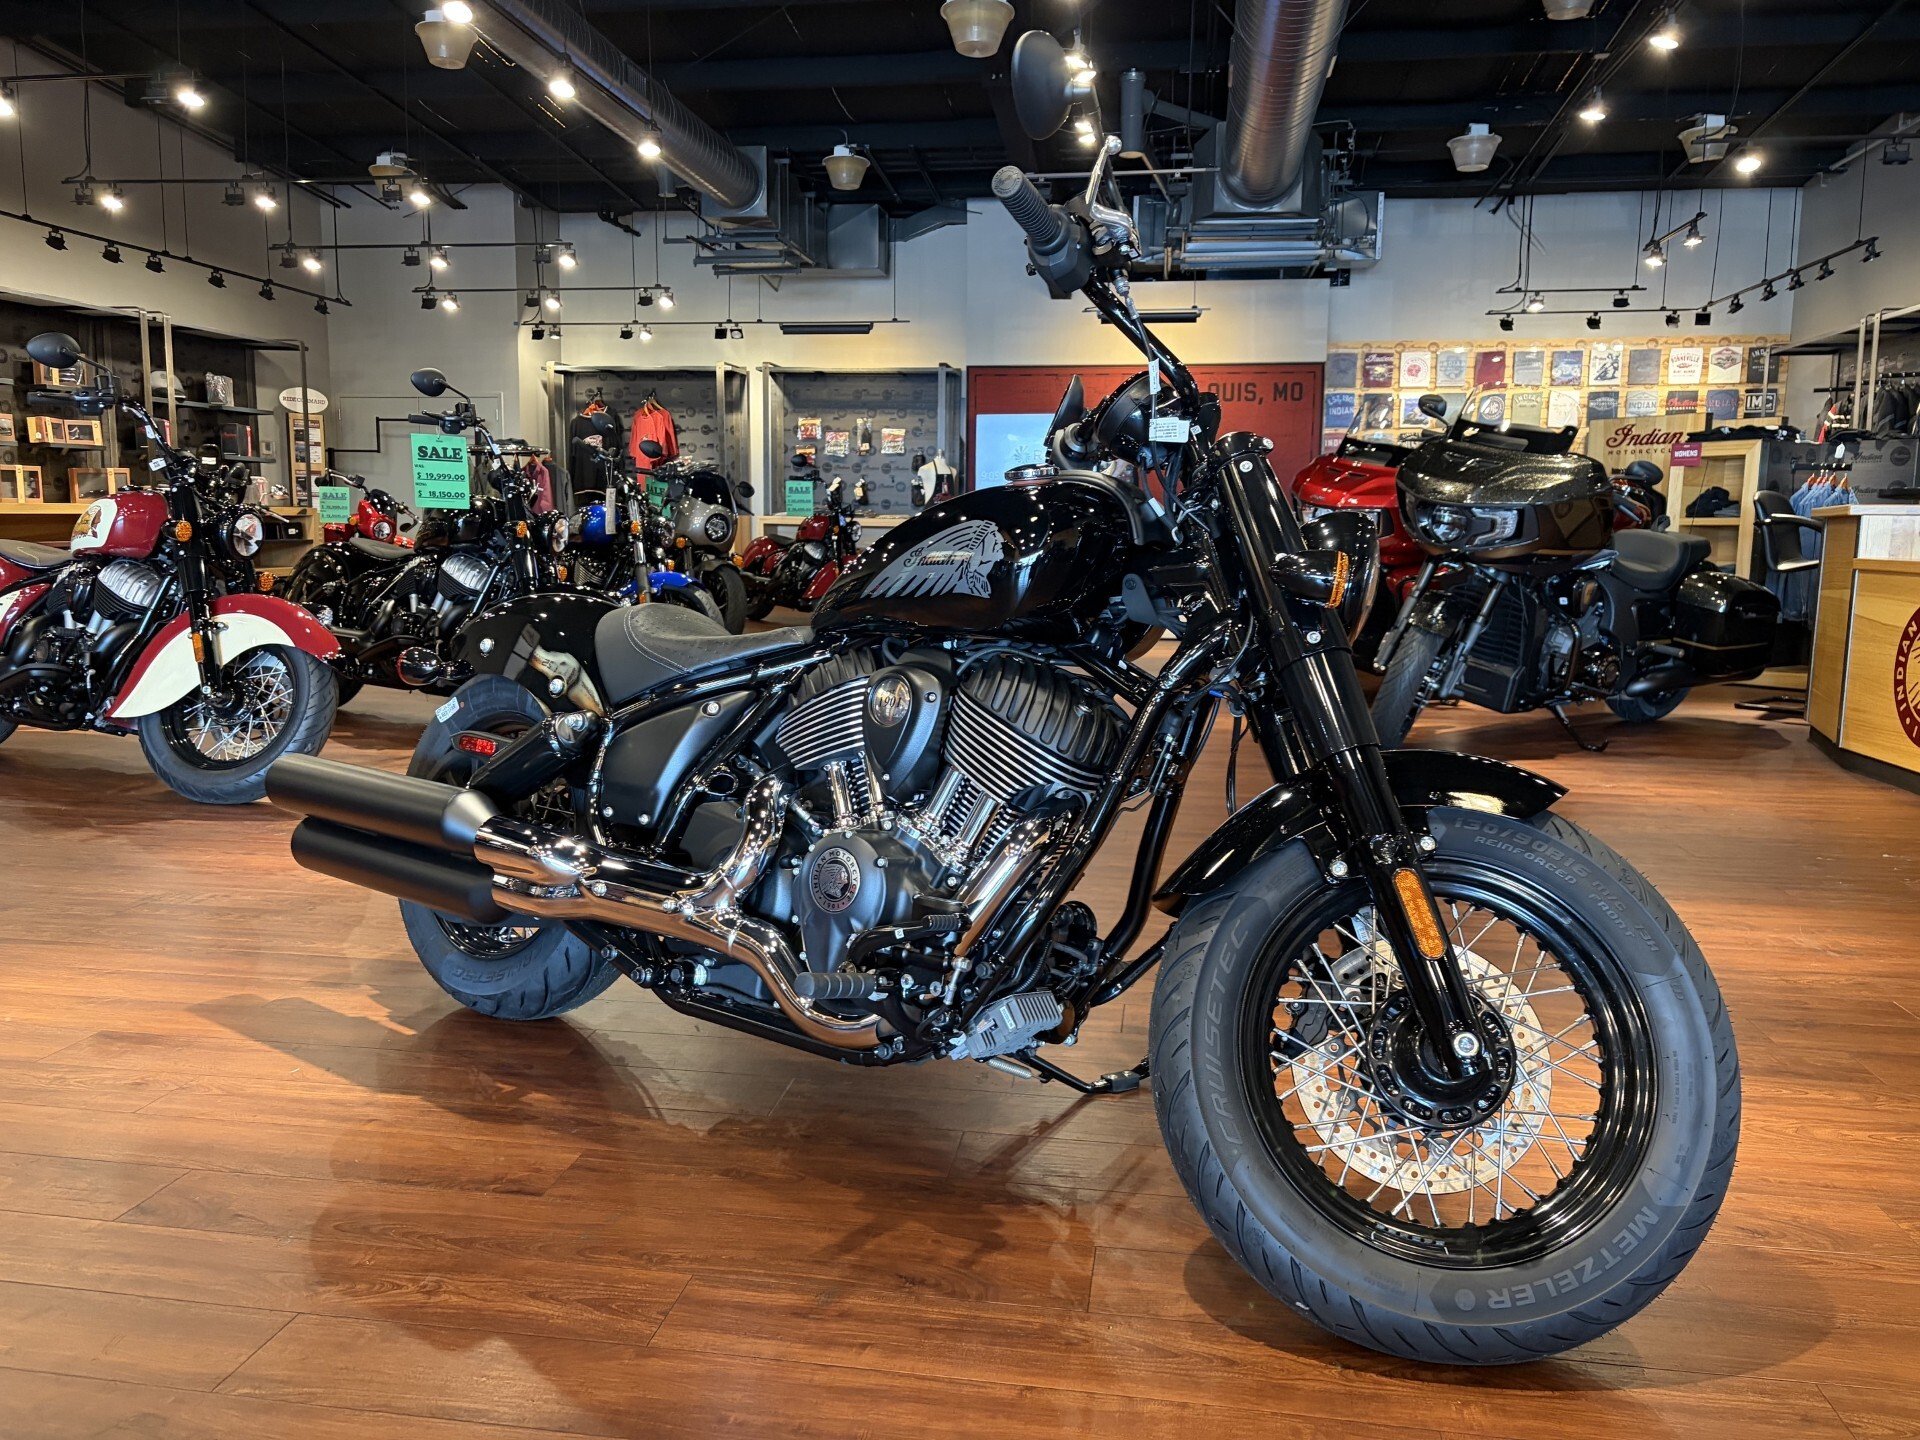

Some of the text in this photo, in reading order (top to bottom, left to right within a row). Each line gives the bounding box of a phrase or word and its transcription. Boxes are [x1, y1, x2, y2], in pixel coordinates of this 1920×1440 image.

[1208, 382, 1303, 405] OUIS, MO
[1328, 406, 1354, 415] INDIAN
[1628, 401, 1656, 409] INDIAN
[1606, 423, 1683, 448] Indian
[417, 445, 463, 460] SALE
[1608, 447, 1671, 455] MOTORCYCL
[1675, 449, 1698, 457] WOMENS
[425, 472, 465, 481] 19,999.00
[322, 492, 347, 500] SALE
[429, 490, 465, 498] 18,150.00
[788, 486, 811, 494] SALE
[903, 547, 955, 567] Indian
[1896, 620, 1918, 711] INDIAN
[879, 696, 902, 708] 1901
[1474, 836, 1577, 884] REINFORCED
[813, 856, 826, 893] INDIAN
[829, 850, 858, 899] MOTORCYCLE
[823, 900, 840, 909] 1901
[1203, 918, 1248, 1145] CRUISETEC
[1487, 1205, 1660, 1308] METZELER
